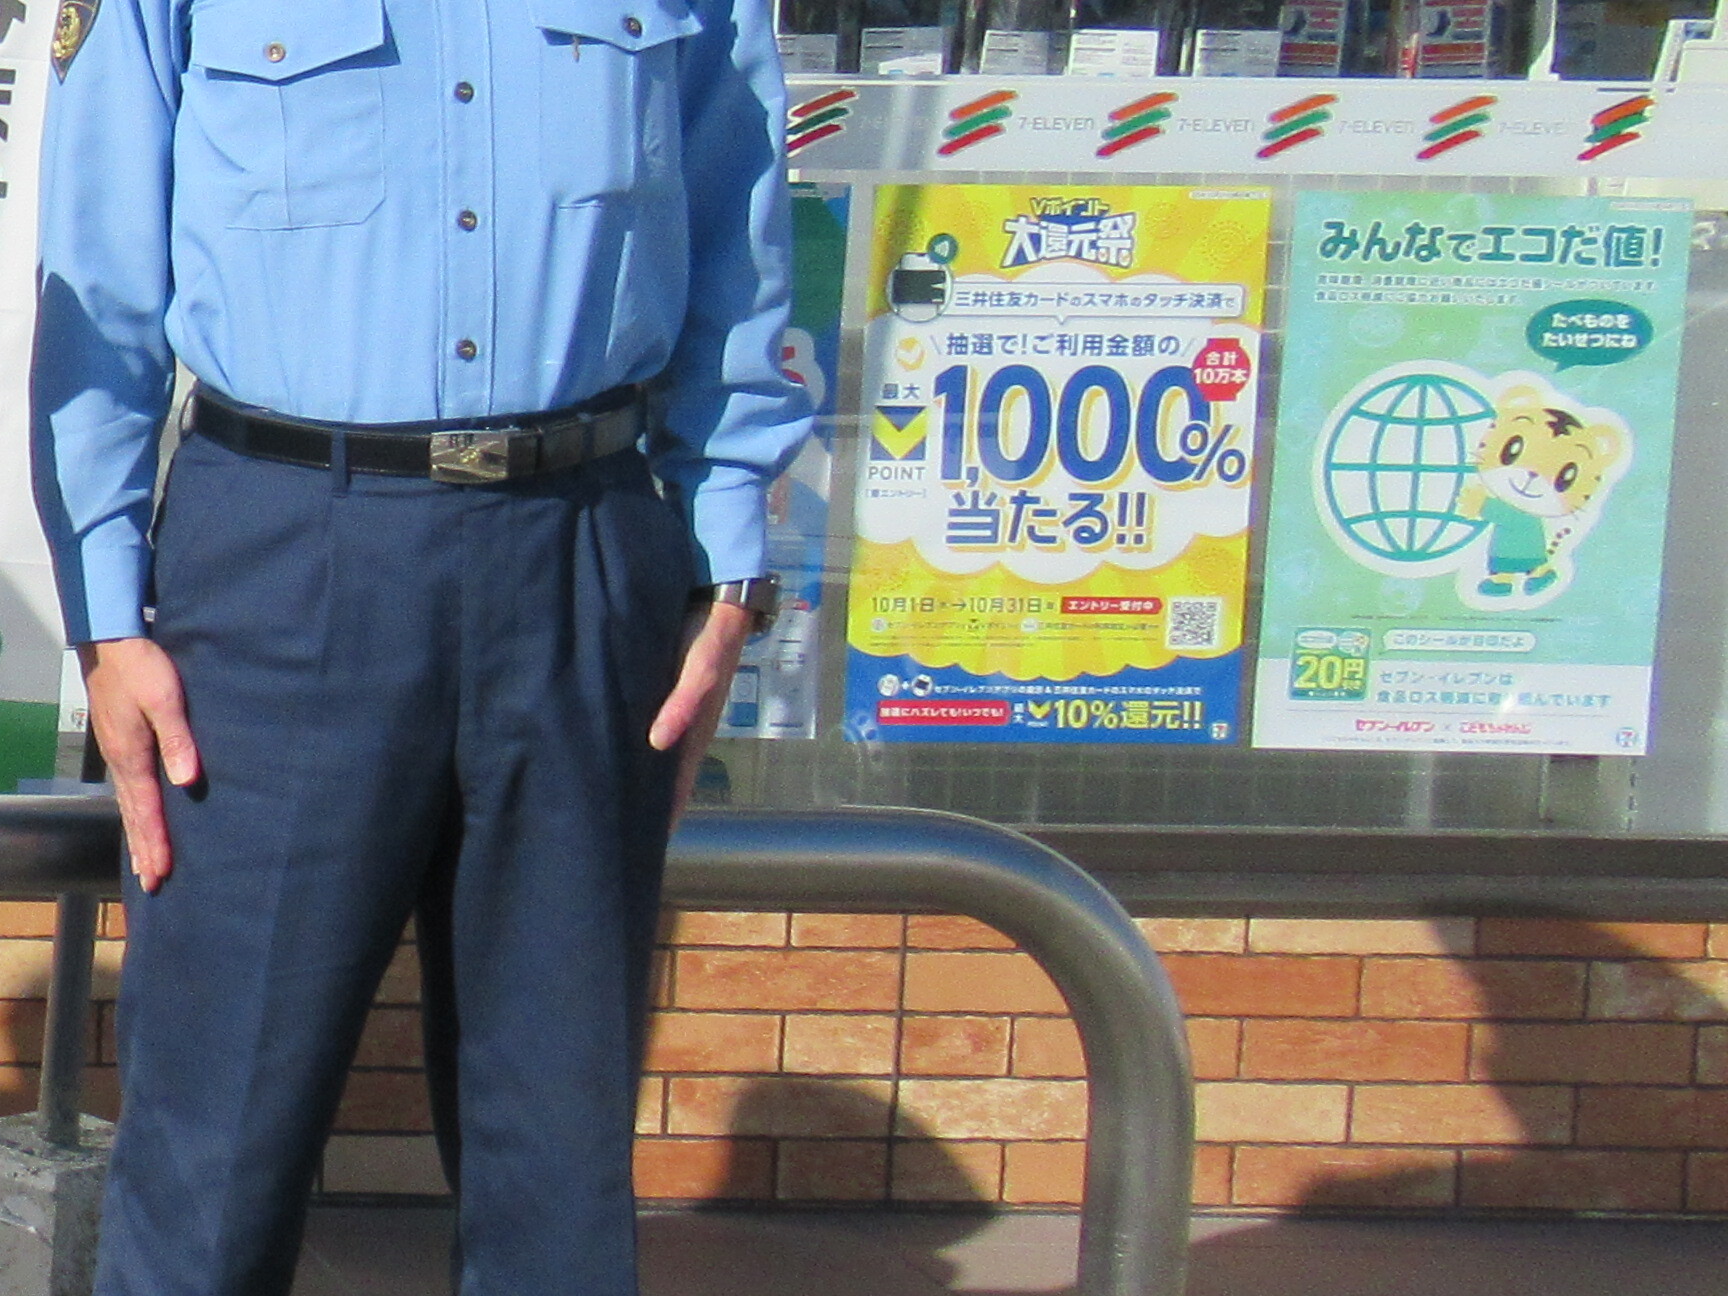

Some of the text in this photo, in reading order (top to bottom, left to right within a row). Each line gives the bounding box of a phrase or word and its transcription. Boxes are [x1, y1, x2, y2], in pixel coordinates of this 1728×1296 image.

[1000, 212, 1137, 268] 大還元祭
[1318, 219, 1664, 268] みんなでエコだ値!
[1205, 351, 1237, 366] 合計
[1194, 367, 1248, 385] 10万本
[868, 465, 926, 481] POINT
[944, 489, 1146, 545] 当たる!!
